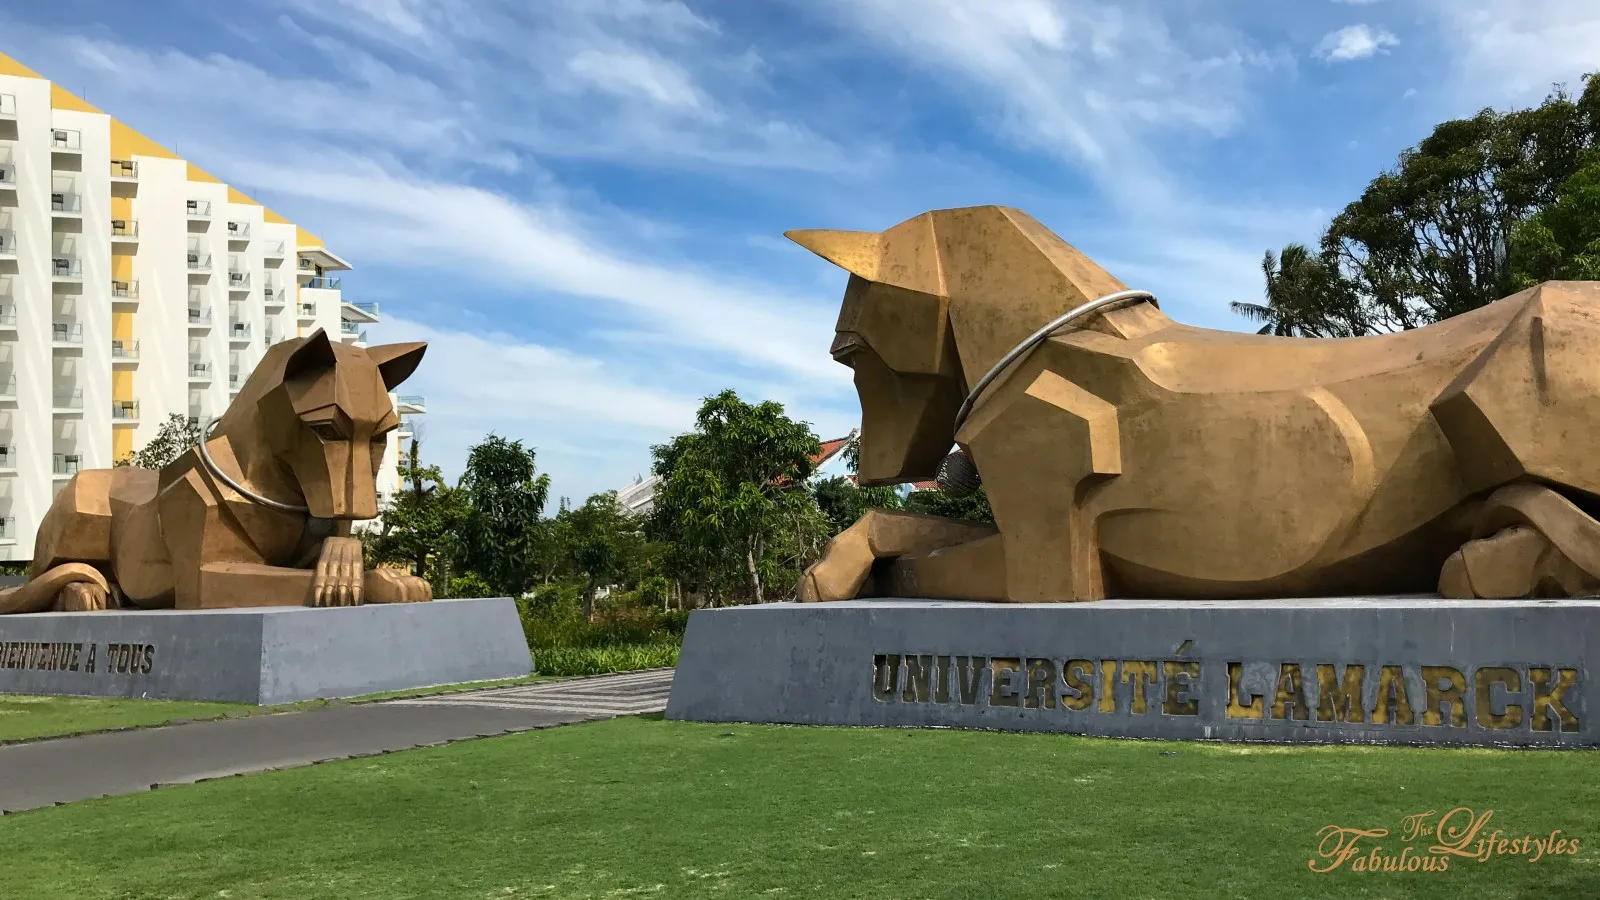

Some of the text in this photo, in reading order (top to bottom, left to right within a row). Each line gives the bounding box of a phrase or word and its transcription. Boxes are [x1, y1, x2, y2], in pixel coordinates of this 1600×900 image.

[0, 641, 155, 675] IENVENUE A TOUS
[872, 640, 1580, 732] UNIVERSITÉ LAMARCK
